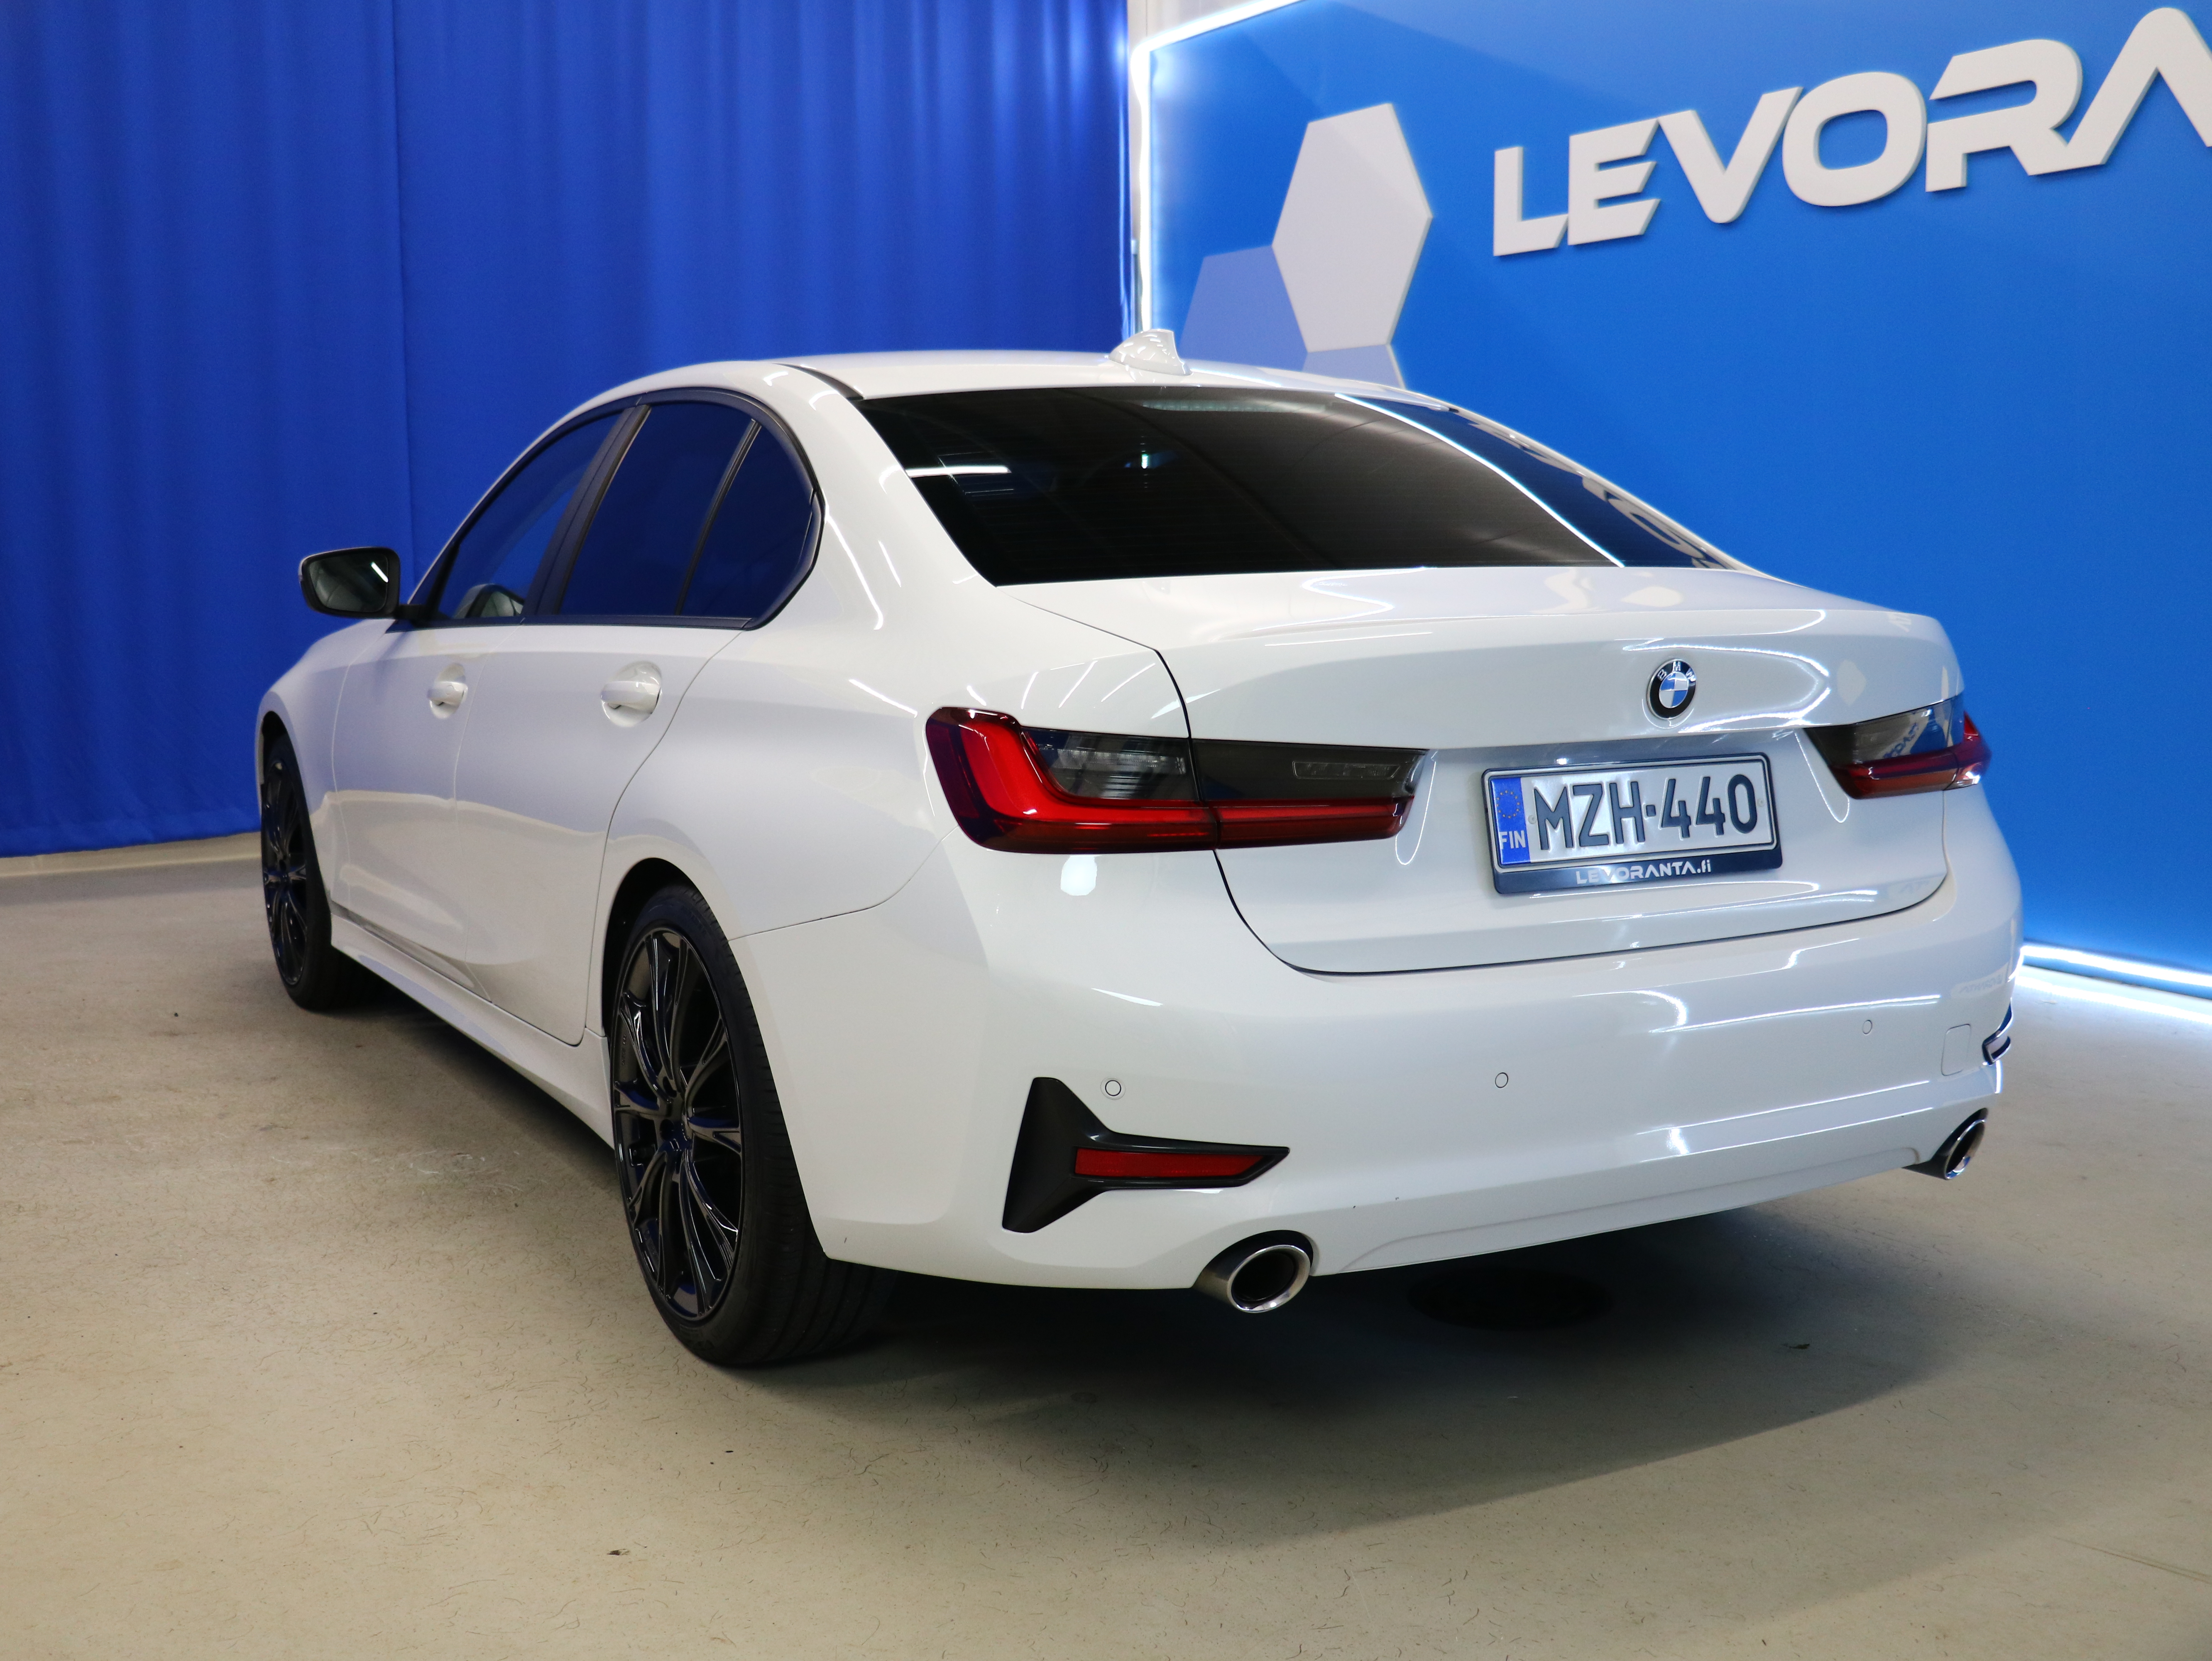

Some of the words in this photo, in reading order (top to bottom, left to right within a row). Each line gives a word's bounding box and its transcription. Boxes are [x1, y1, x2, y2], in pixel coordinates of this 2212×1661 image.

[1493, 7, 2212, 256] LEVORA
[1657, 661, 1696, 682] BMW
[1533, 774, 1758, 850] MZH-440
[1499, 830, 1526, 850] FIN
